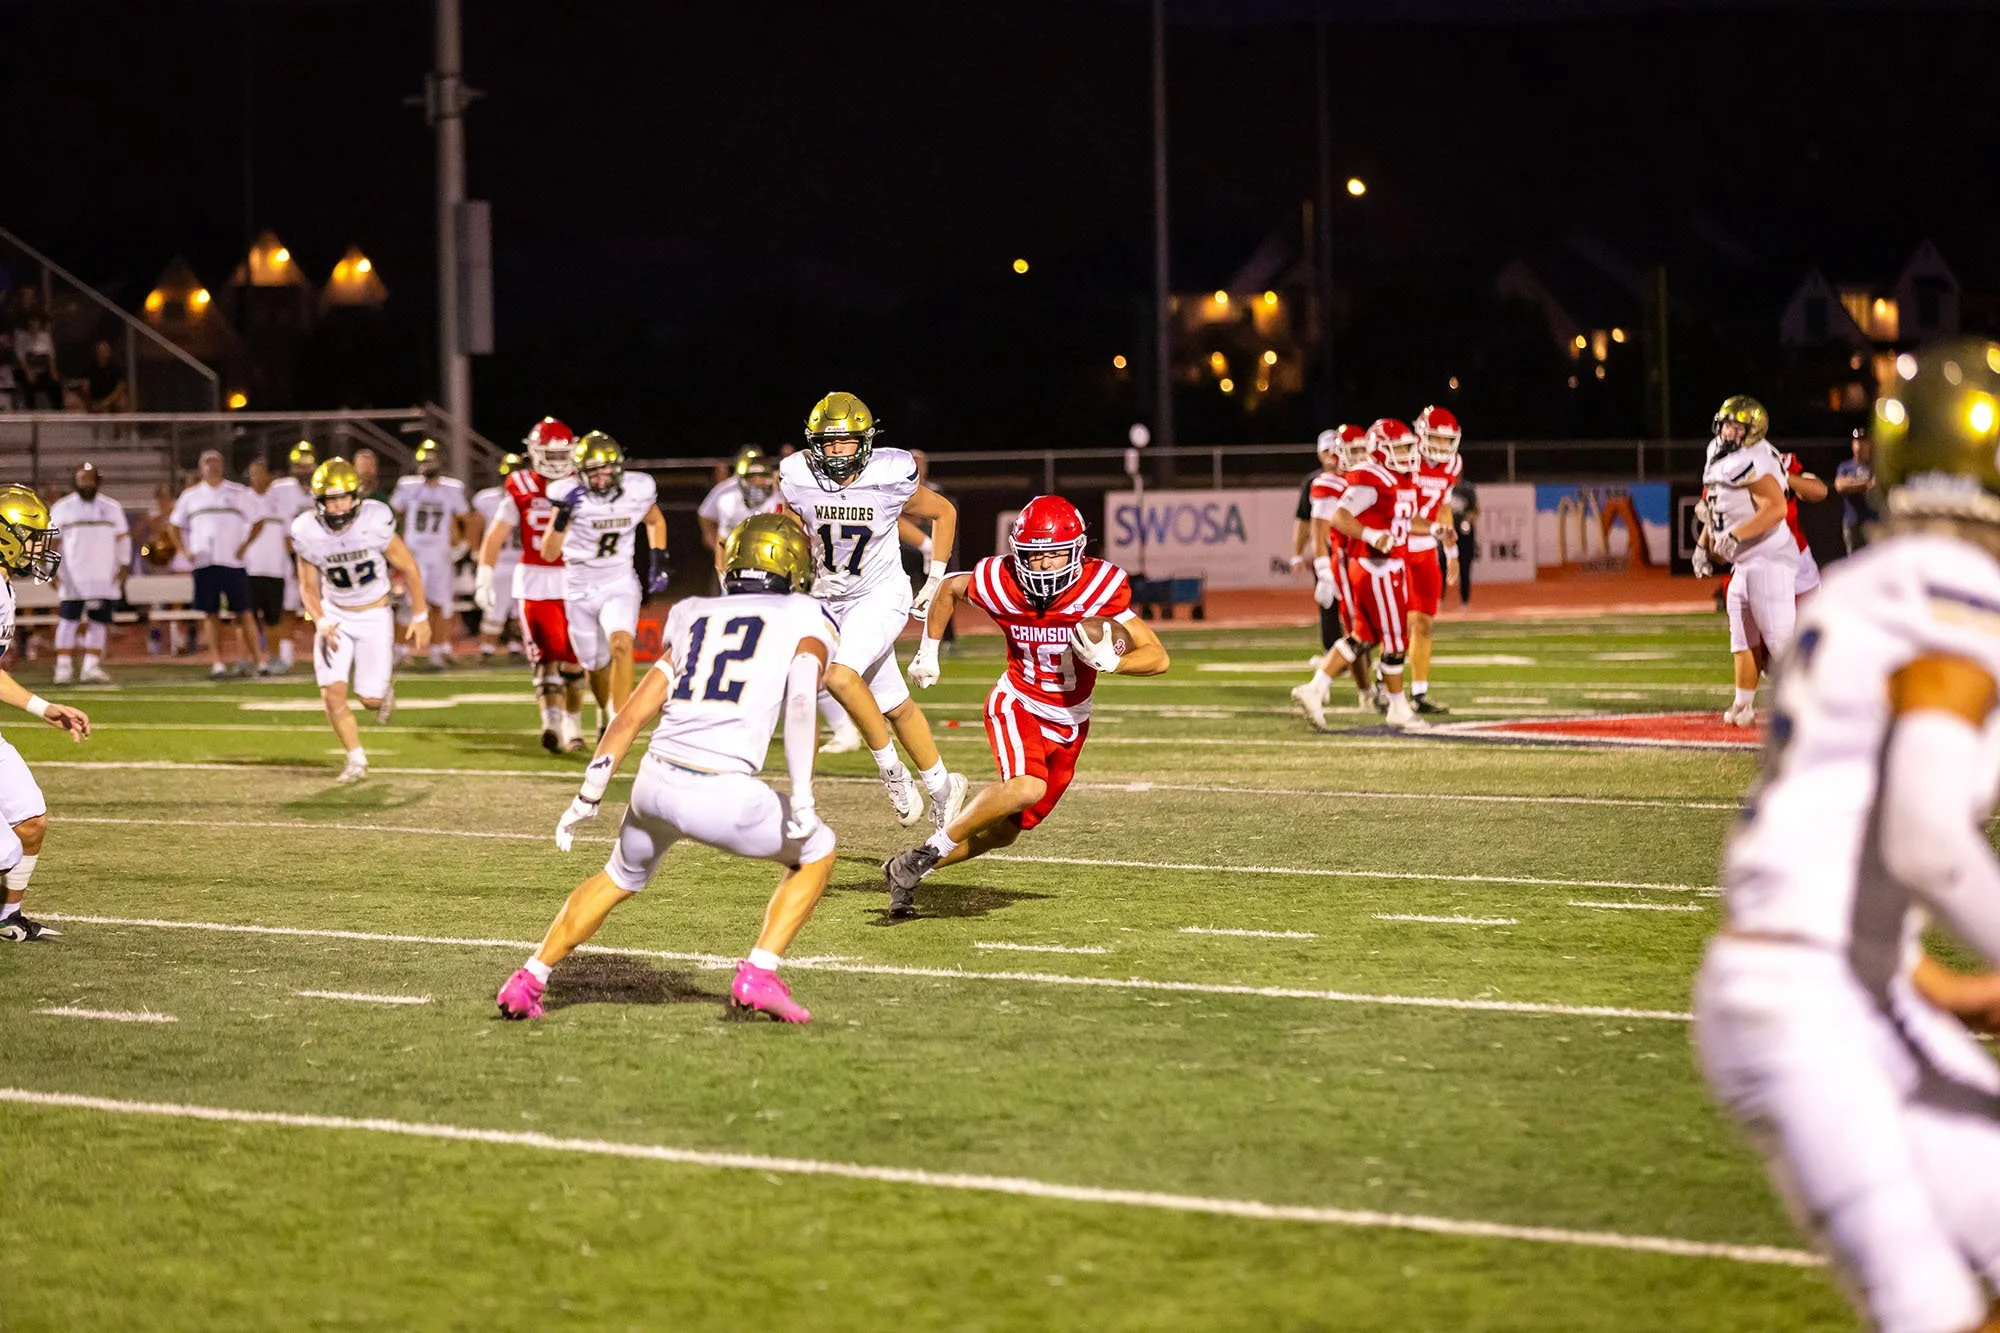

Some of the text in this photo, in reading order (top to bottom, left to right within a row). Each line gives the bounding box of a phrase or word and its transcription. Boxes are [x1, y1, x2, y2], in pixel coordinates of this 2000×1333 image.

[814, 504, 874, 521] WARRIORS
[1421, 487, 1442, 520] 7
[1114, 503, 1247, 546] SWOSA
[597, 532, 620, 558] 8
[816, 522, 874, 577] 17
[1010, 624, 1077, 643] CRIMSON
[671, 615, 766, 704] 12
[1016, 641, 1077, 692] 19
